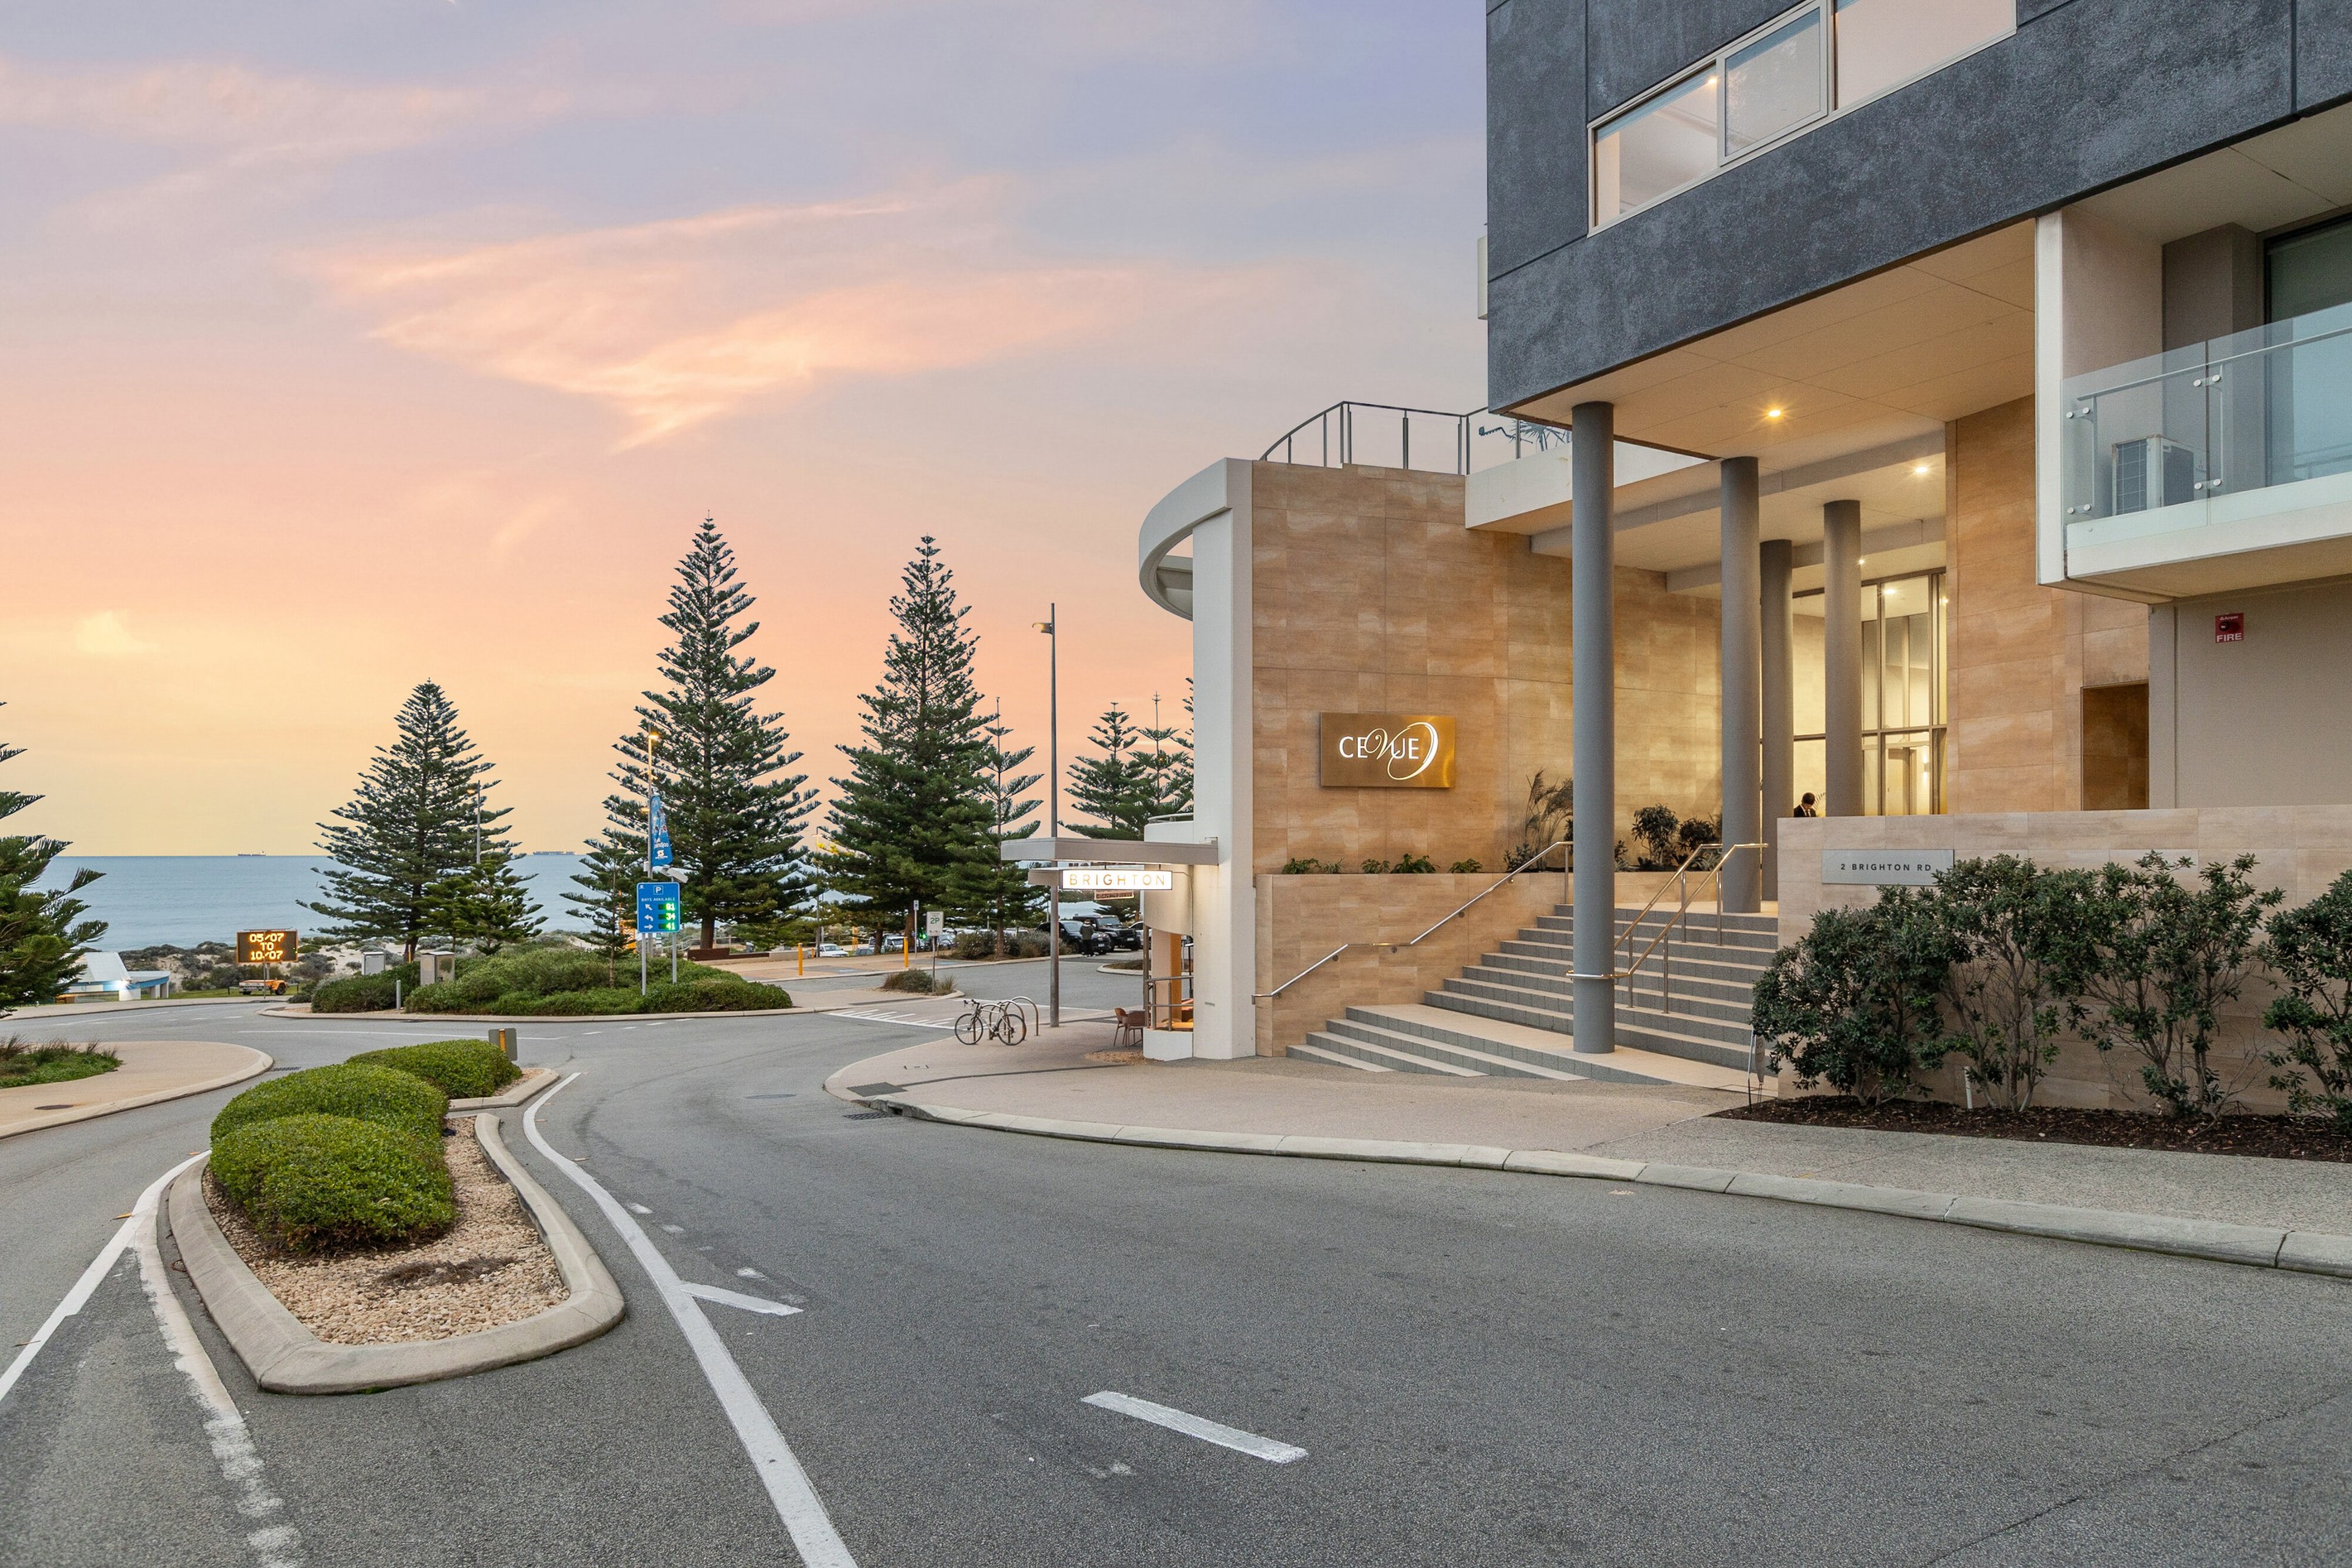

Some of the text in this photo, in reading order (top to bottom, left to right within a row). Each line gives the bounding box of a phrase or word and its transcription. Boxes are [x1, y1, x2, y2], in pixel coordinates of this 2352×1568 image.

[2216, 632, 2243, 642] FIRE
[1070, 873, 1165, 886] BRIGHTON
[250, 933, 284, 942] 05/07
[260, 942, 274, 950] TO
[251, 951, 283, 960] 10/07
